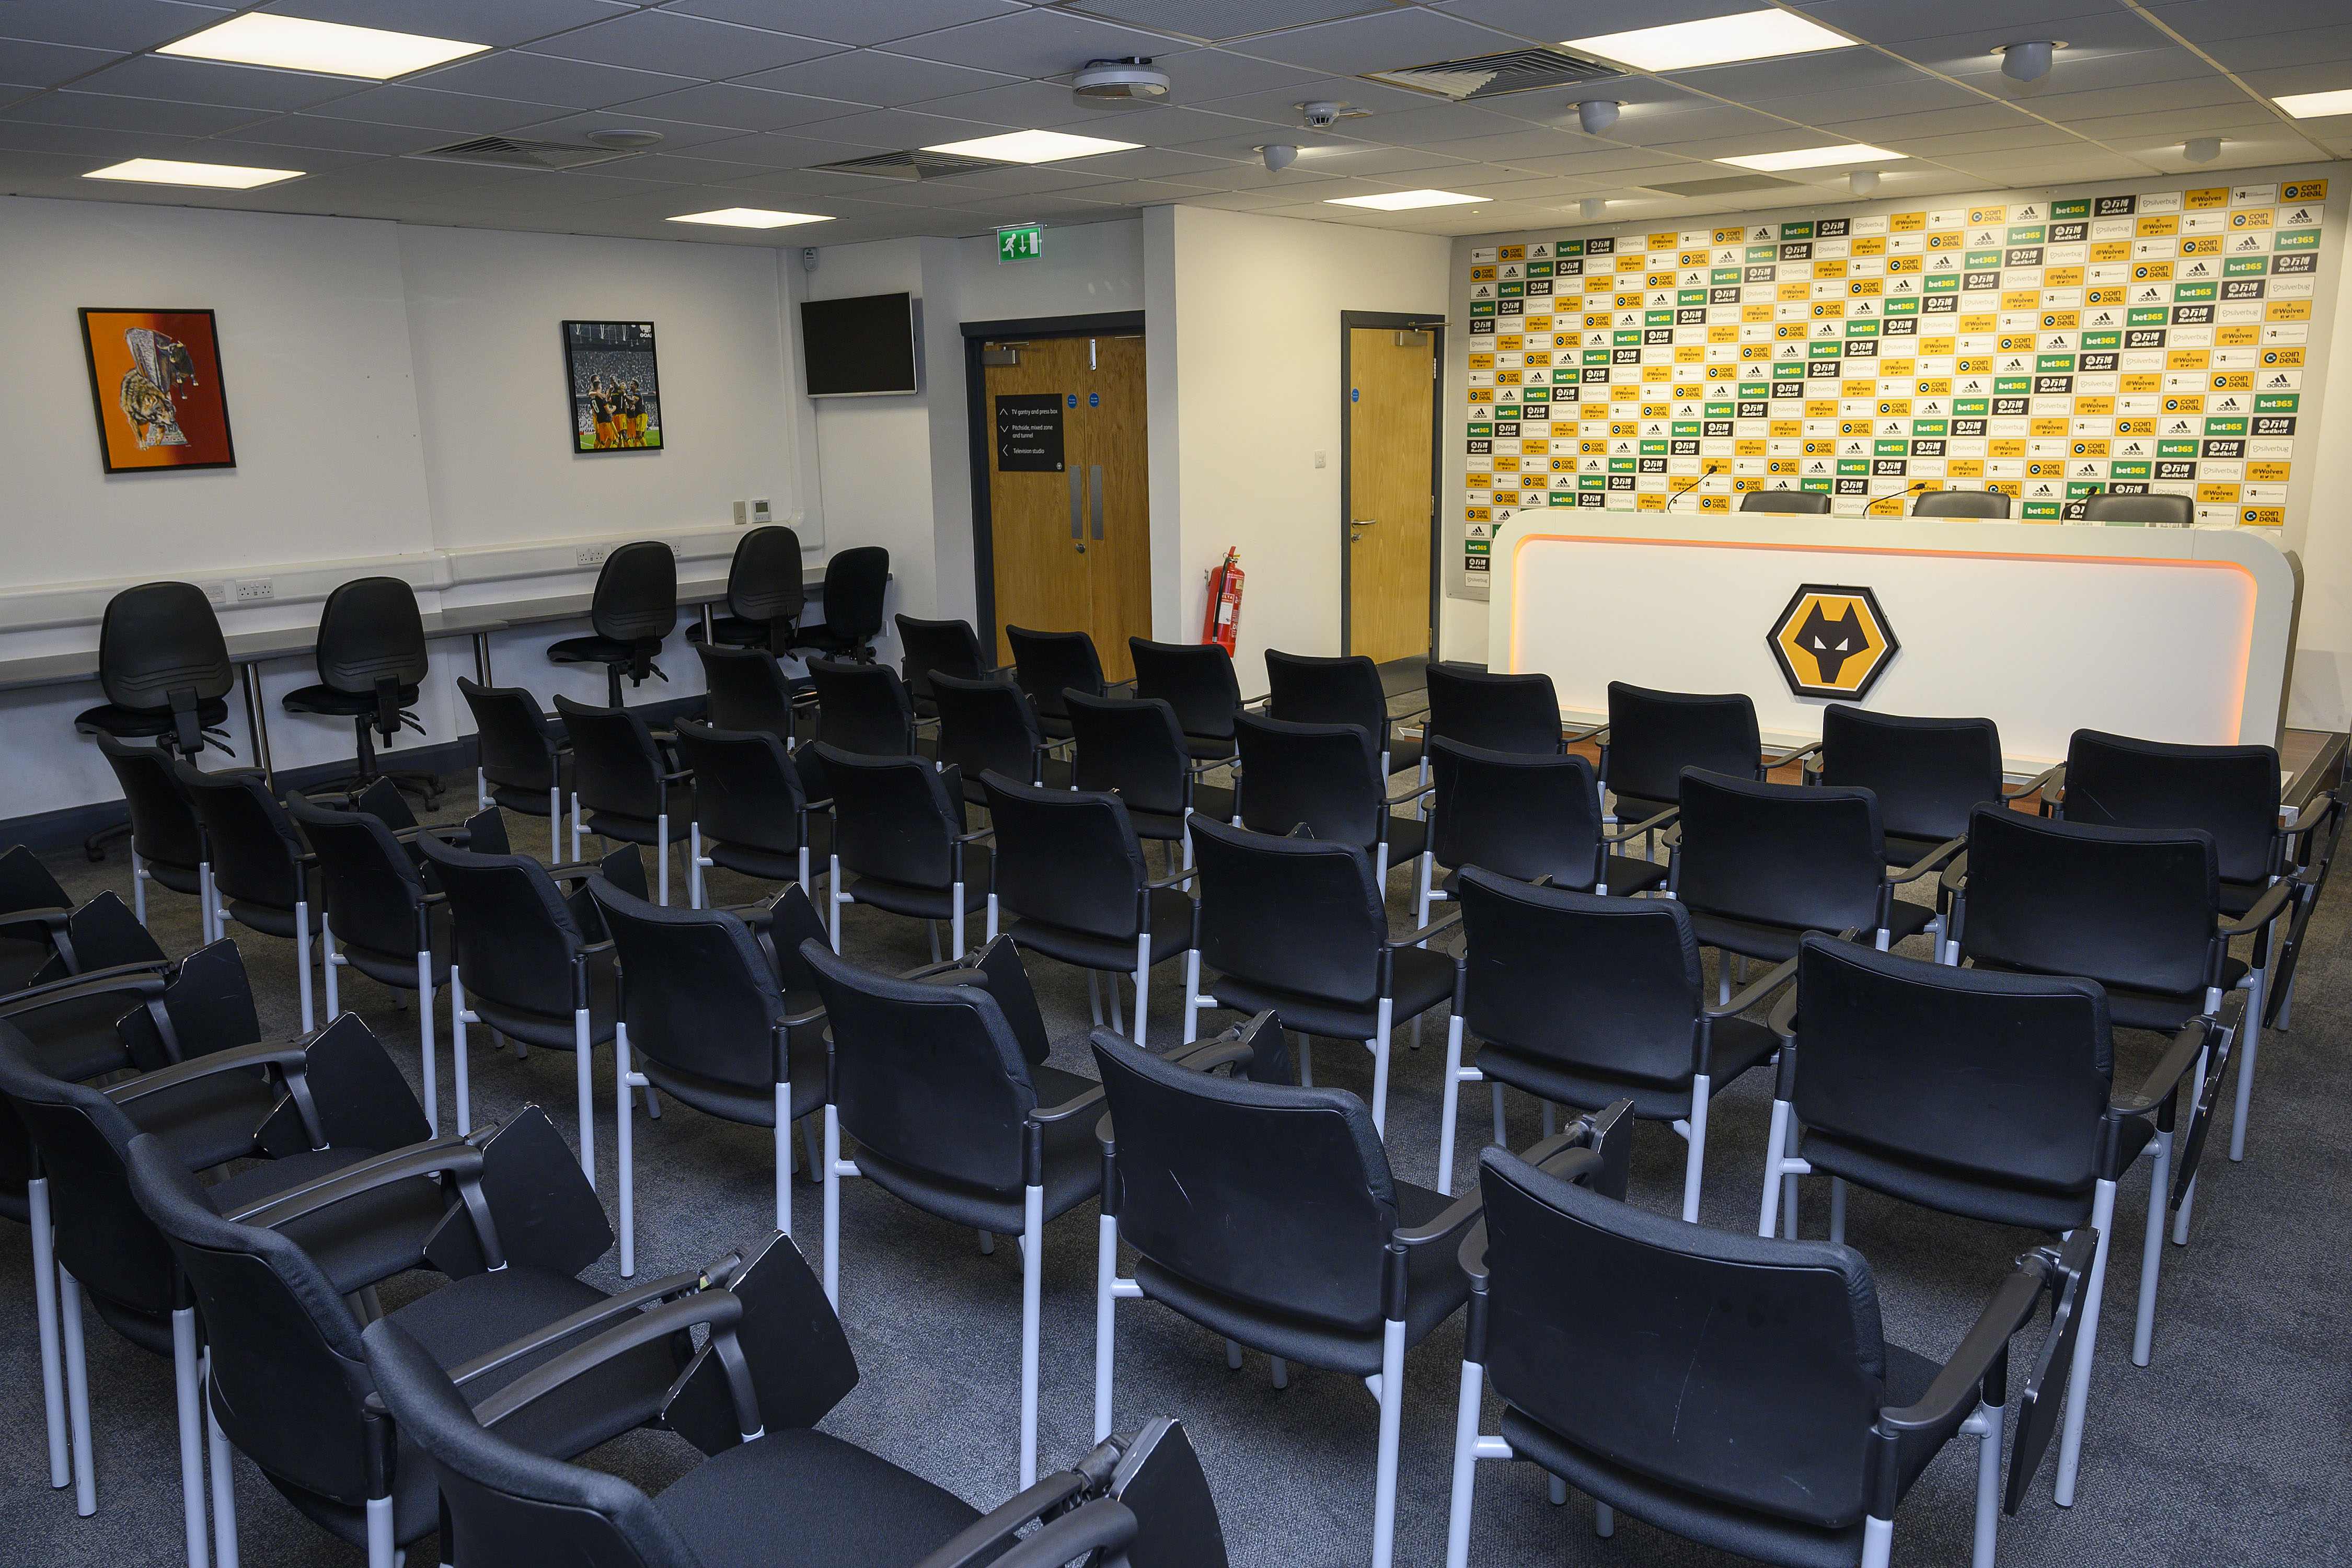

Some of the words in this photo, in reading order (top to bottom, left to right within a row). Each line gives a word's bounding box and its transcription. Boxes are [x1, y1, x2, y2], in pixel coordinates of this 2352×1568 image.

[2150, 198, 2177, 206] silverbug
[2056, 205, 2085, 214] bet365
[2103, 224, 2129, 233] silverbug
[2012, 230, 2040, 239] bet365
[2280, 235, 2315, 245] bet365
[2229, 262, 2262, 271] bet365
[2180, 288, 2211, 296] bet365
[2131, 313, 2163, 321] bet365
